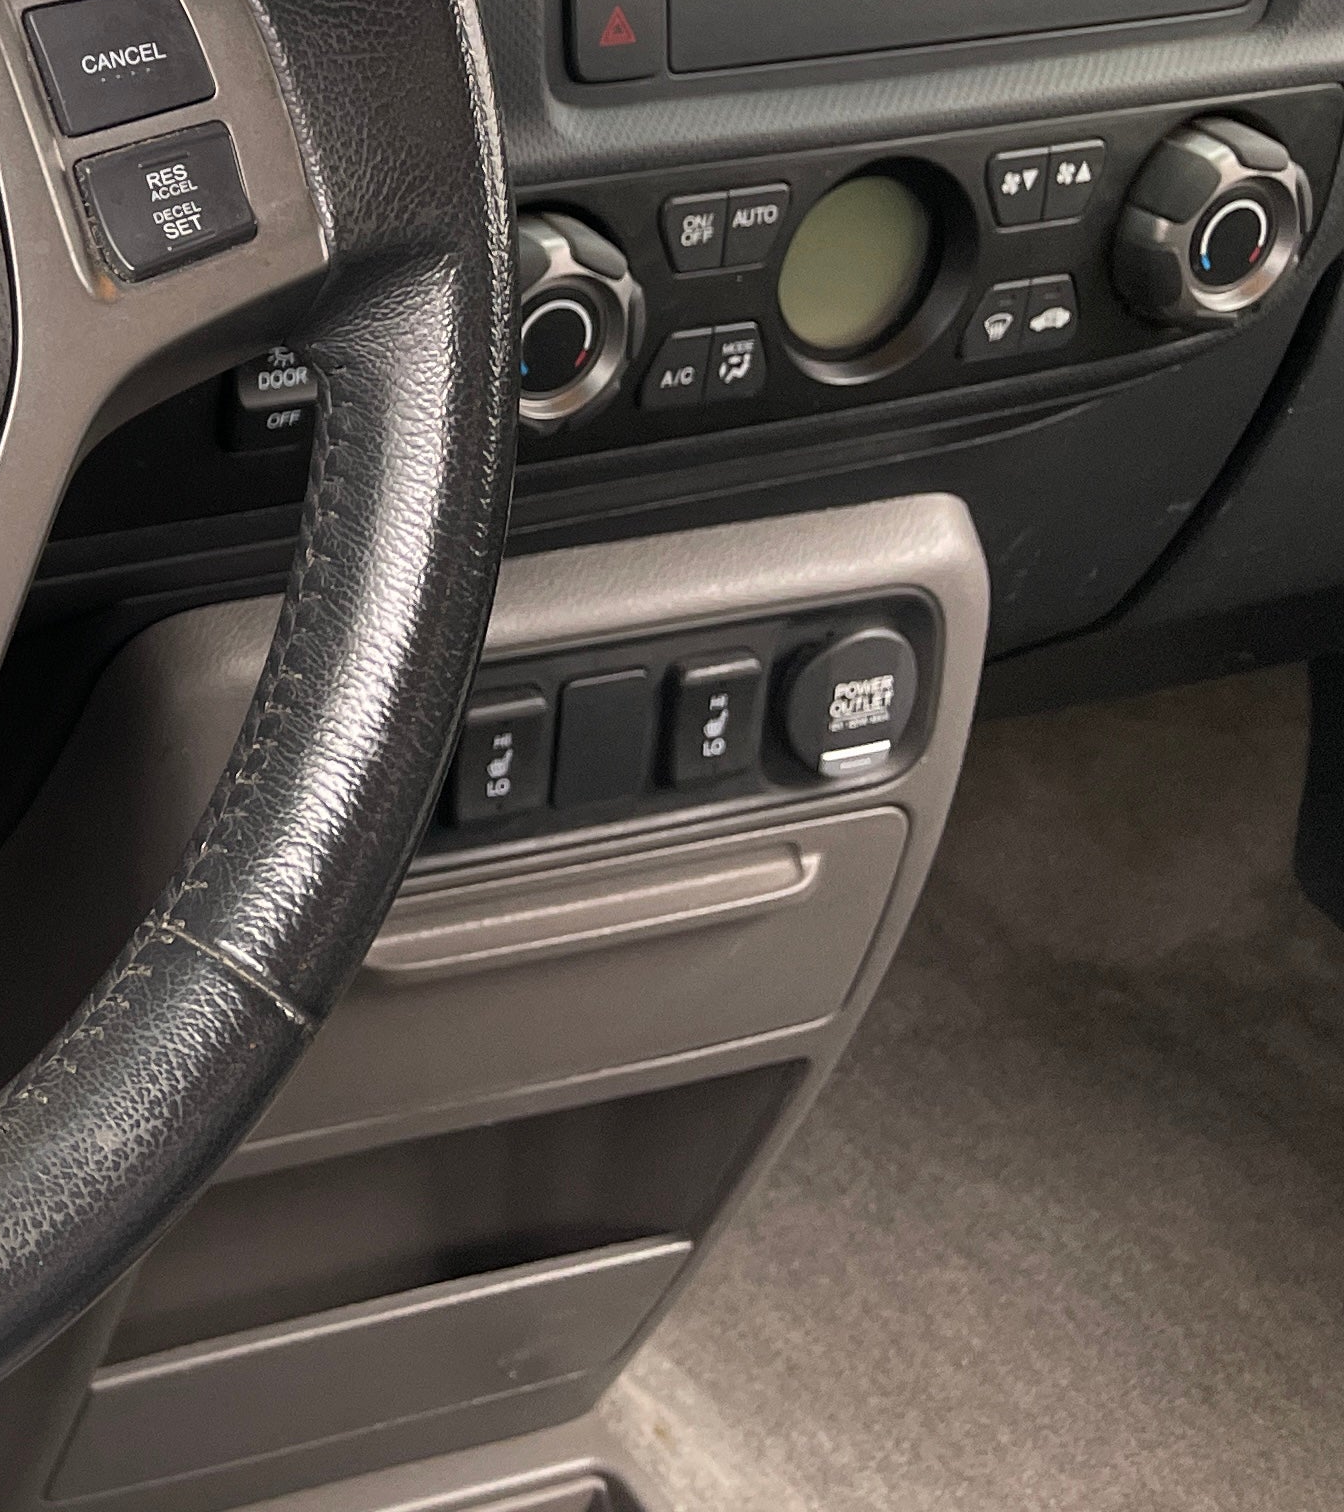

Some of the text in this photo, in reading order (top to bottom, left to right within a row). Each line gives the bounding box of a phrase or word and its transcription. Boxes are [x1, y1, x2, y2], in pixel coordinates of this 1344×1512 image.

[81, 42, 167, 75] CANCEL
[145, 163, 189, 190] RES
[151, 179, 199, 203] ACCEL
[152, 200, 203, 226] DECEL
[732, 204, 779, 229] AUTO
[163, 214, 204, 241] SET
[681, 227, 714, 247] OFF
[258, 366, 308, 390] DOOR
[660, 365, 696, 389] A/C
[266, 410, 301, 430] OFF
[834, 674, 894, 701] POWER
[829, 690, 894, 718] OUTLET
